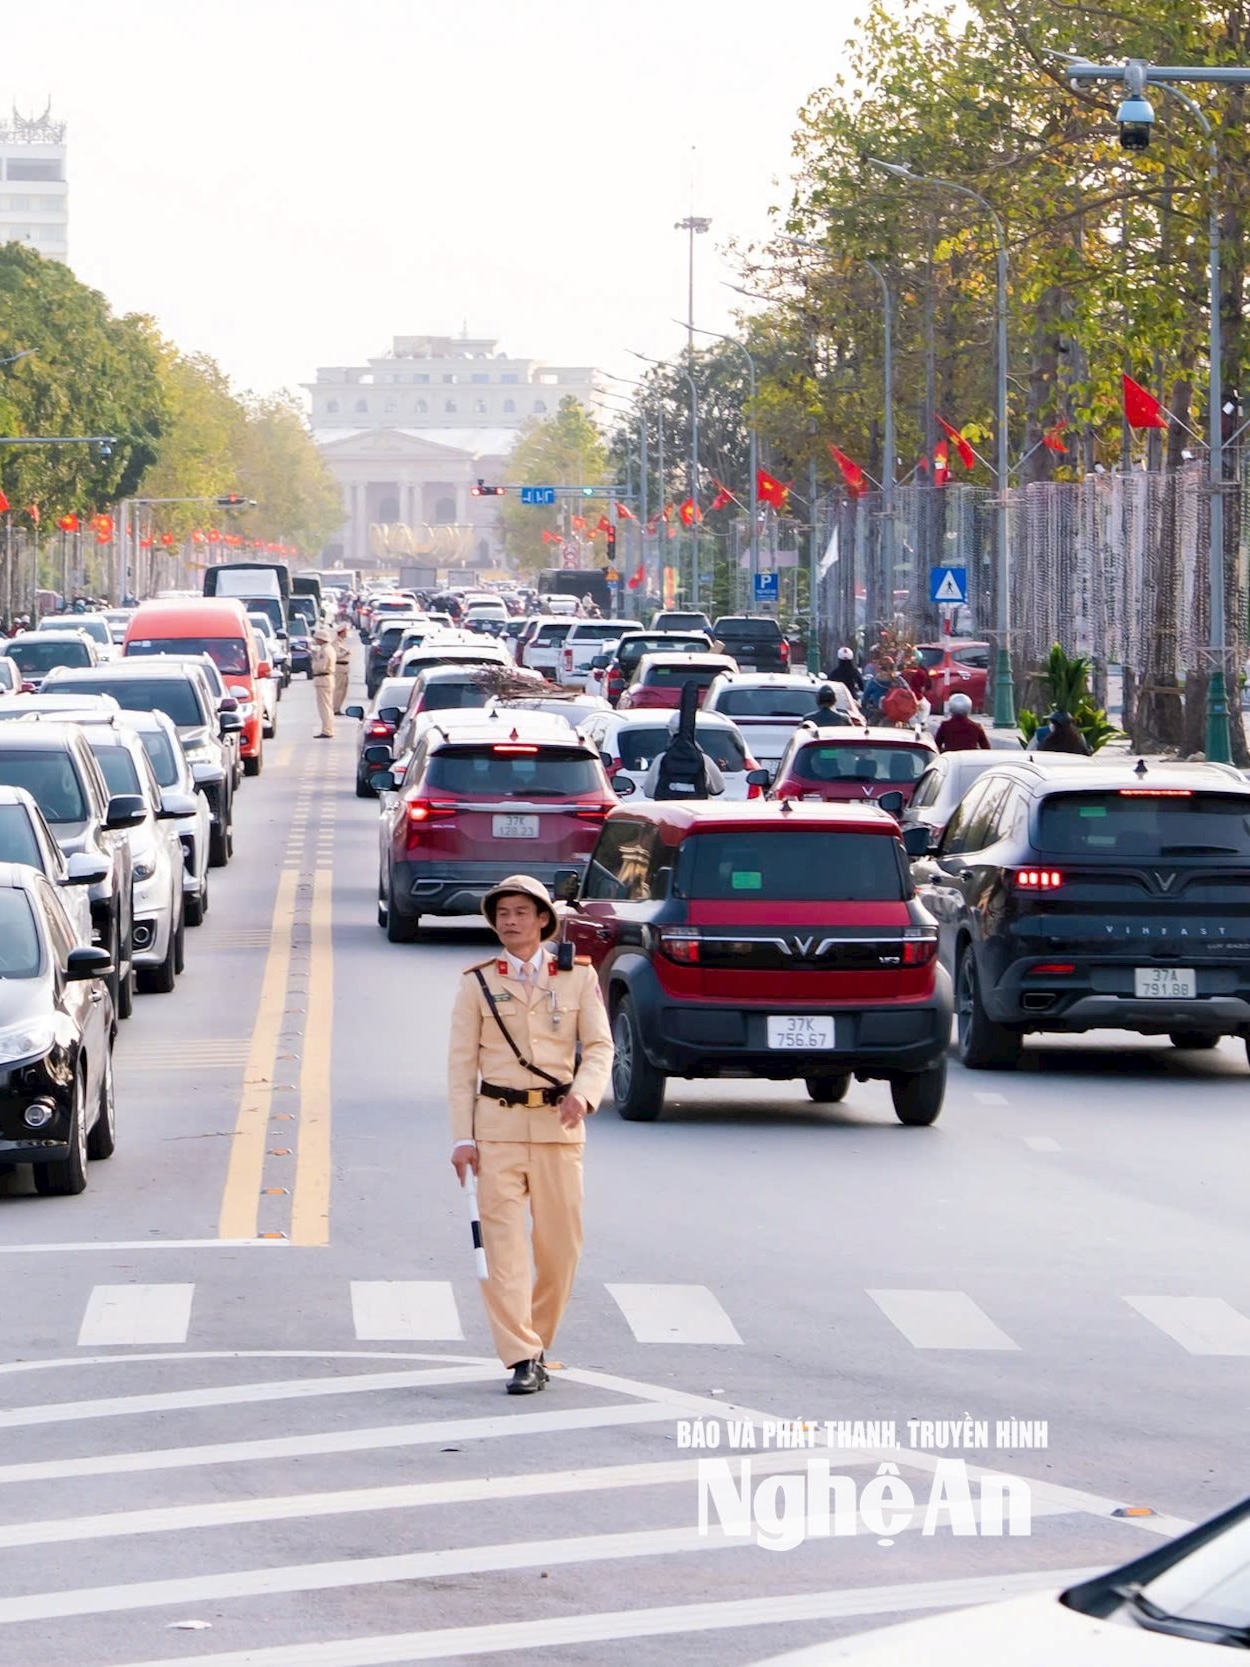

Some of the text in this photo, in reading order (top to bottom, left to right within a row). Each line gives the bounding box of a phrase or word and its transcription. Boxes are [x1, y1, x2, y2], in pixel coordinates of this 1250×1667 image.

[760, 575, 772, 589] P
[1106, 926, 1226, 935] VINFAST
[1152, 969, 1178, 981] 37A
[1142, 983, 1189, 995] 791.88
[787, 1018, 814, 1031] 37K
[777, 1033, 827, 1047] 756.67
